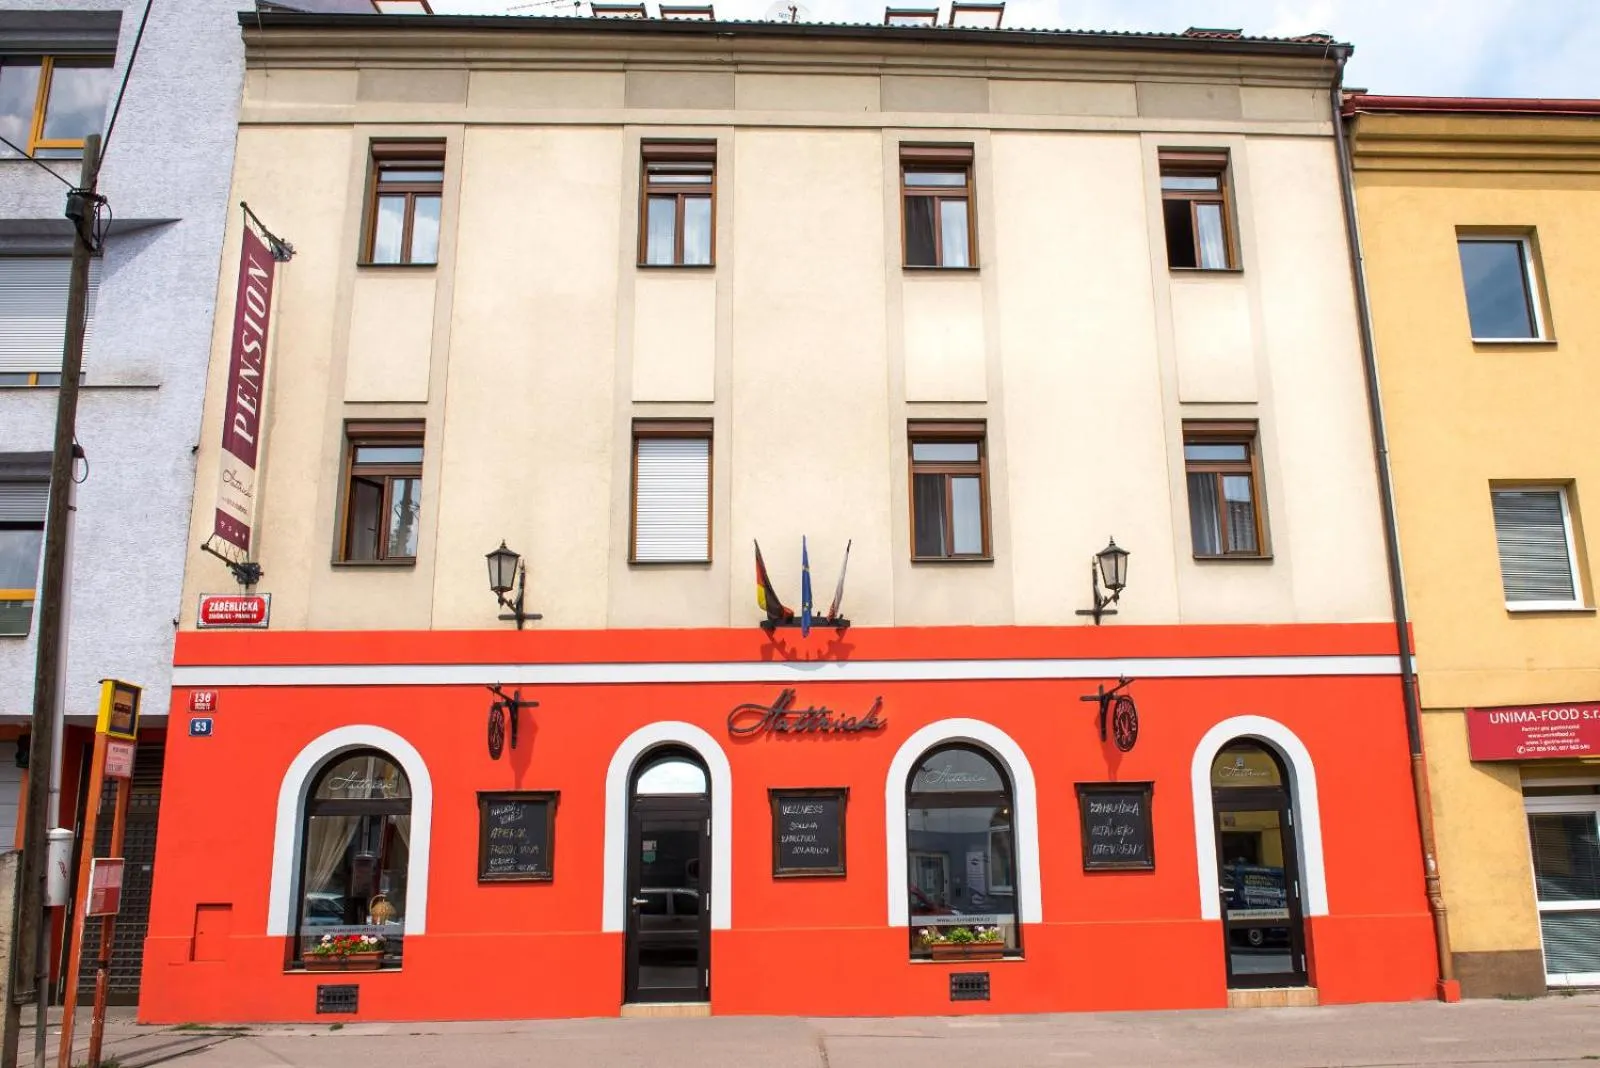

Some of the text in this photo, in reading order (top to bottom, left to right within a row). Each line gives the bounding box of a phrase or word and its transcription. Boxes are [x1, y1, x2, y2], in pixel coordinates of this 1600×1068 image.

[232, 253, 270, 444] PENSION
[727, 688, 888, 734] Hattrick
[1489, 708, 1580, 724] UNIMA-FOOD
[194, 721, 207, 732] 53
[782, 804, 824, 815] WELLNESS
